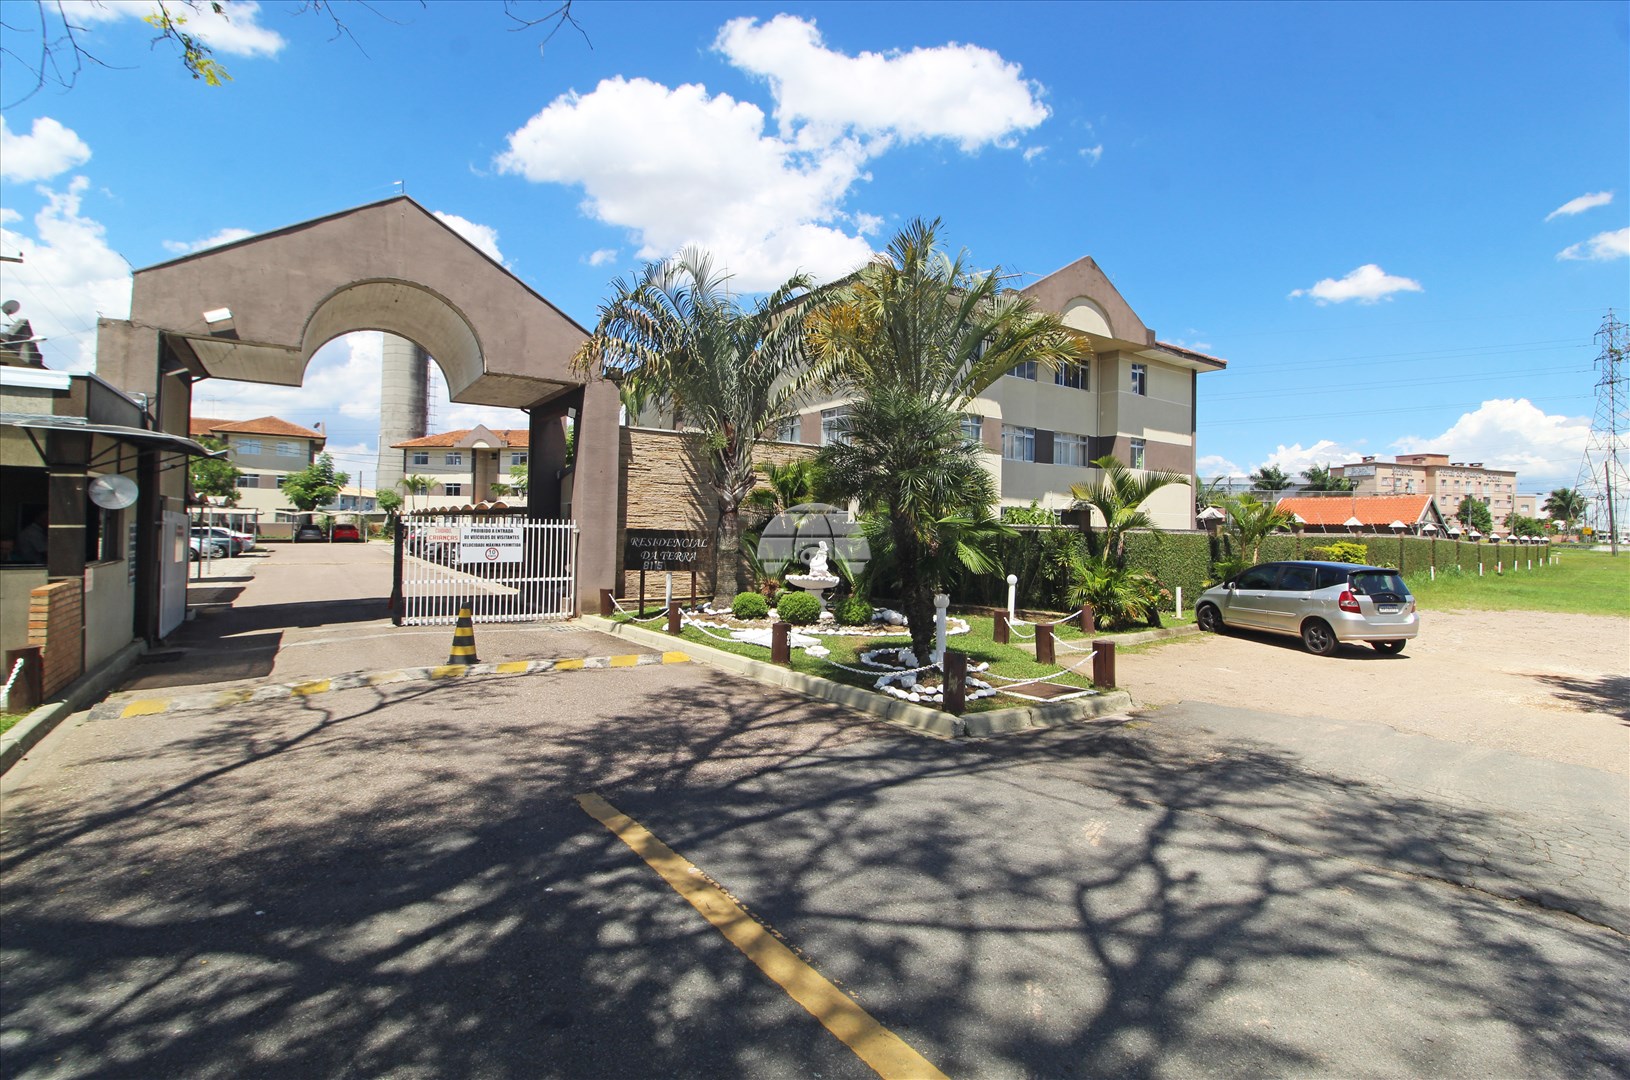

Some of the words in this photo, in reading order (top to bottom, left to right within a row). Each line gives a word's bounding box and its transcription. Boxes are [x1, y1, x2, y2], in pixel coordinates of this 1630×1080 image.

[631, 536, 708, 548] RESIDENCIAL
[641, 550, 658, 560] DA
[660, 550, 697, 562] TERRA
